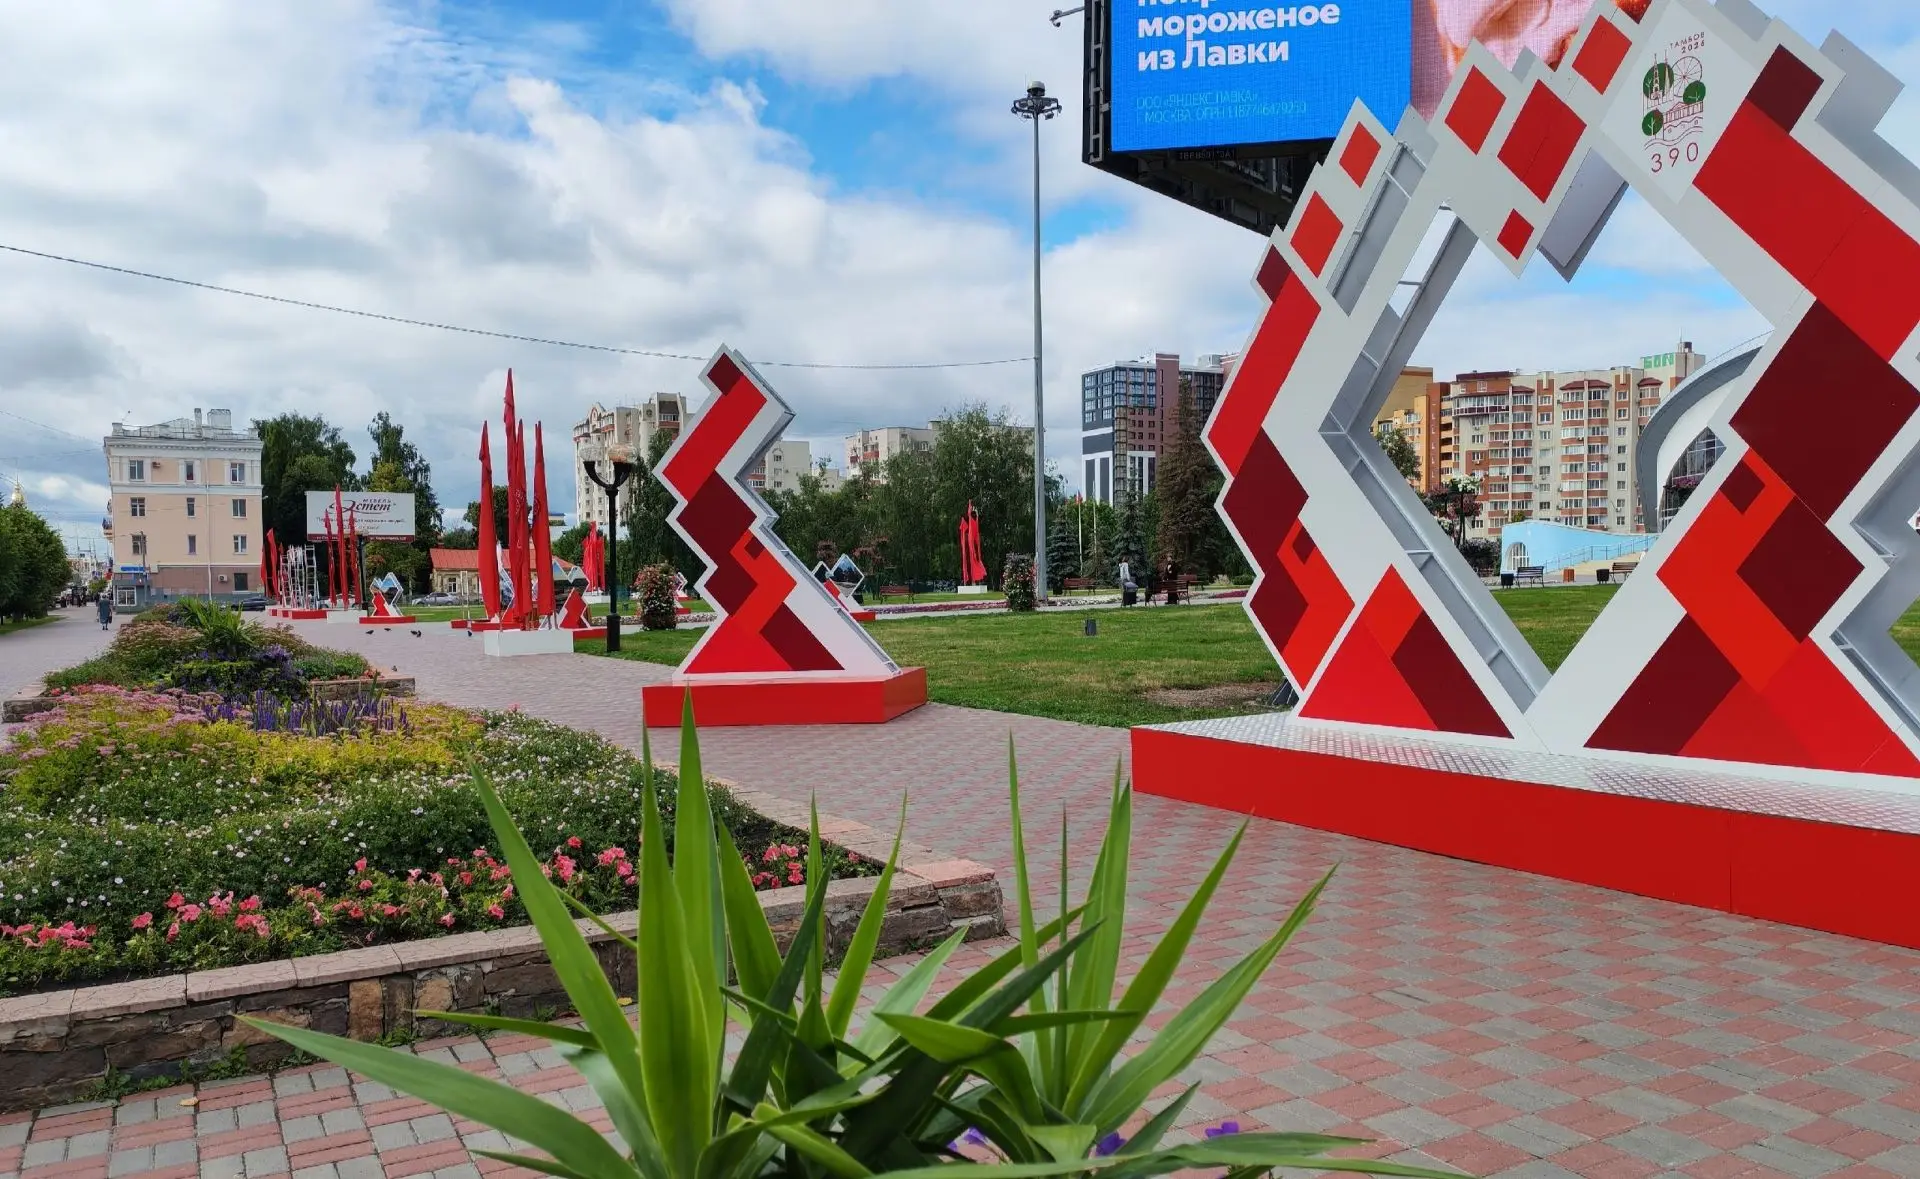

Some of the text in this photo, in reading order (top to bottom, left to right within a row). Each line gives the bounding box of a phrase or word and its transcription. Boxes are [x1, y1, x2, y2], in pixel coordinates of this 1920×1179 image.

[1138, 4, 1340, 38] мороженое
[1138, 40, 1289, 71] из Лавки
[1669, 31, 1705, 49] ТАМБОВ
[1681, 40, 1705, 54] 2026
[1651, 142, 1699, 173] 390
